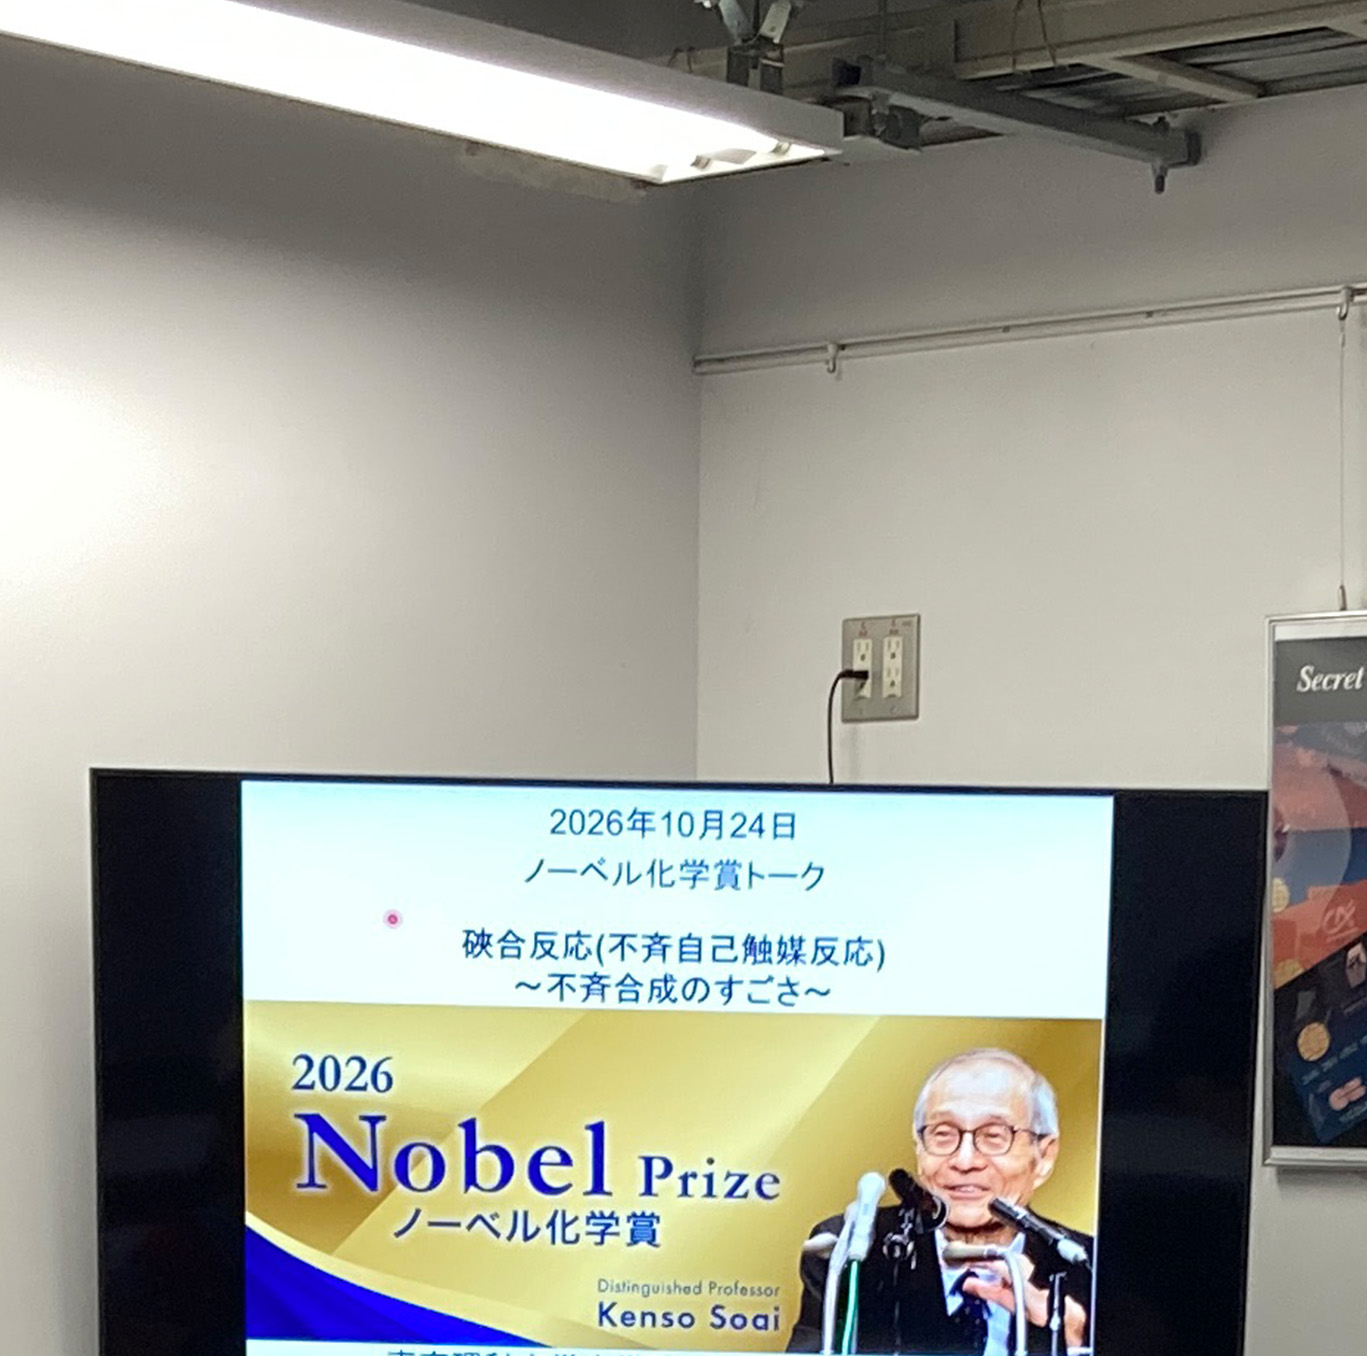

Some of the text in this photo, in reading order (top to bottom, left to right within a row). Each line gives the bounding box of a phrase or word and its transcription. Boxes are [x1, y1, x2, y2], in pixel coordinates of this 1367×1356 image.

[1296, 665, 1365, 692] Secret
[549, 806, 797, 840] 2026年10月24日
[524, 857, 825, 891] ノーベル化学賞トーク
[290, 1053, 394, 1094] 2026
[293, 1112, 781, 1201] Nobel Prize
[392, 1207, 662, 1249] ノーベル化学賞
[597, 1278, 780, 1298] Distinguished Professor
[597, 1301, 780, 1332] Kenso Soai
